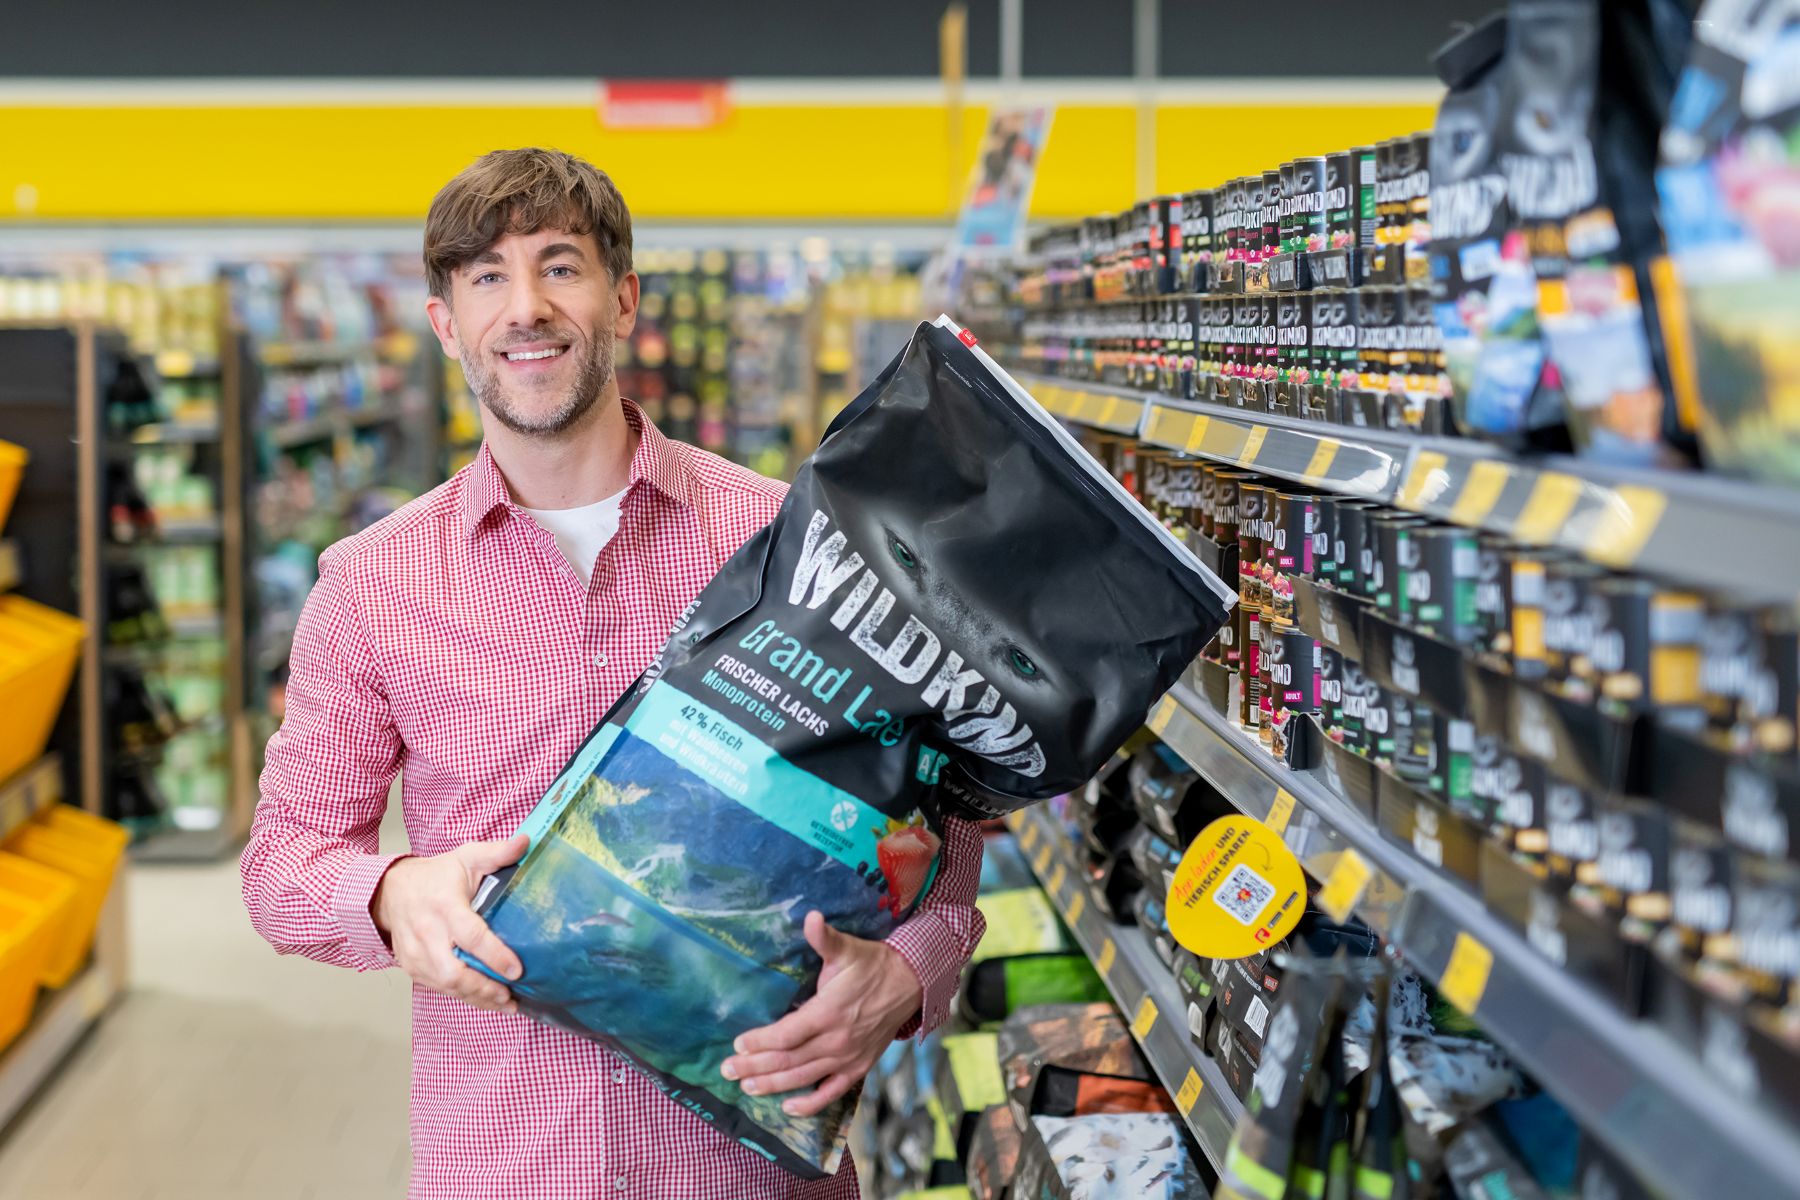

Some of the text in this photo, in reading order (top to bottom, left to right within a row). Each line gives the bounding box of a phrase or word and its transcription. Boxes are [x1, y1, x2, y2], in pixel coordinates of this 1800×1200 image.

[738, 619, 853, 704] Grand
[701, 669, 786, 731] Monoprotein
[714, 654, 829, 737] FRISCHER LACHS
[1285, 691, 1301, 699] ADULT
[681, 705, 697, 721] 42
[709, 721, 744, 751] Fisch
[1216, 827, 1236, 849] UND
[1184, 866, 1221, 909] TIERISCH
